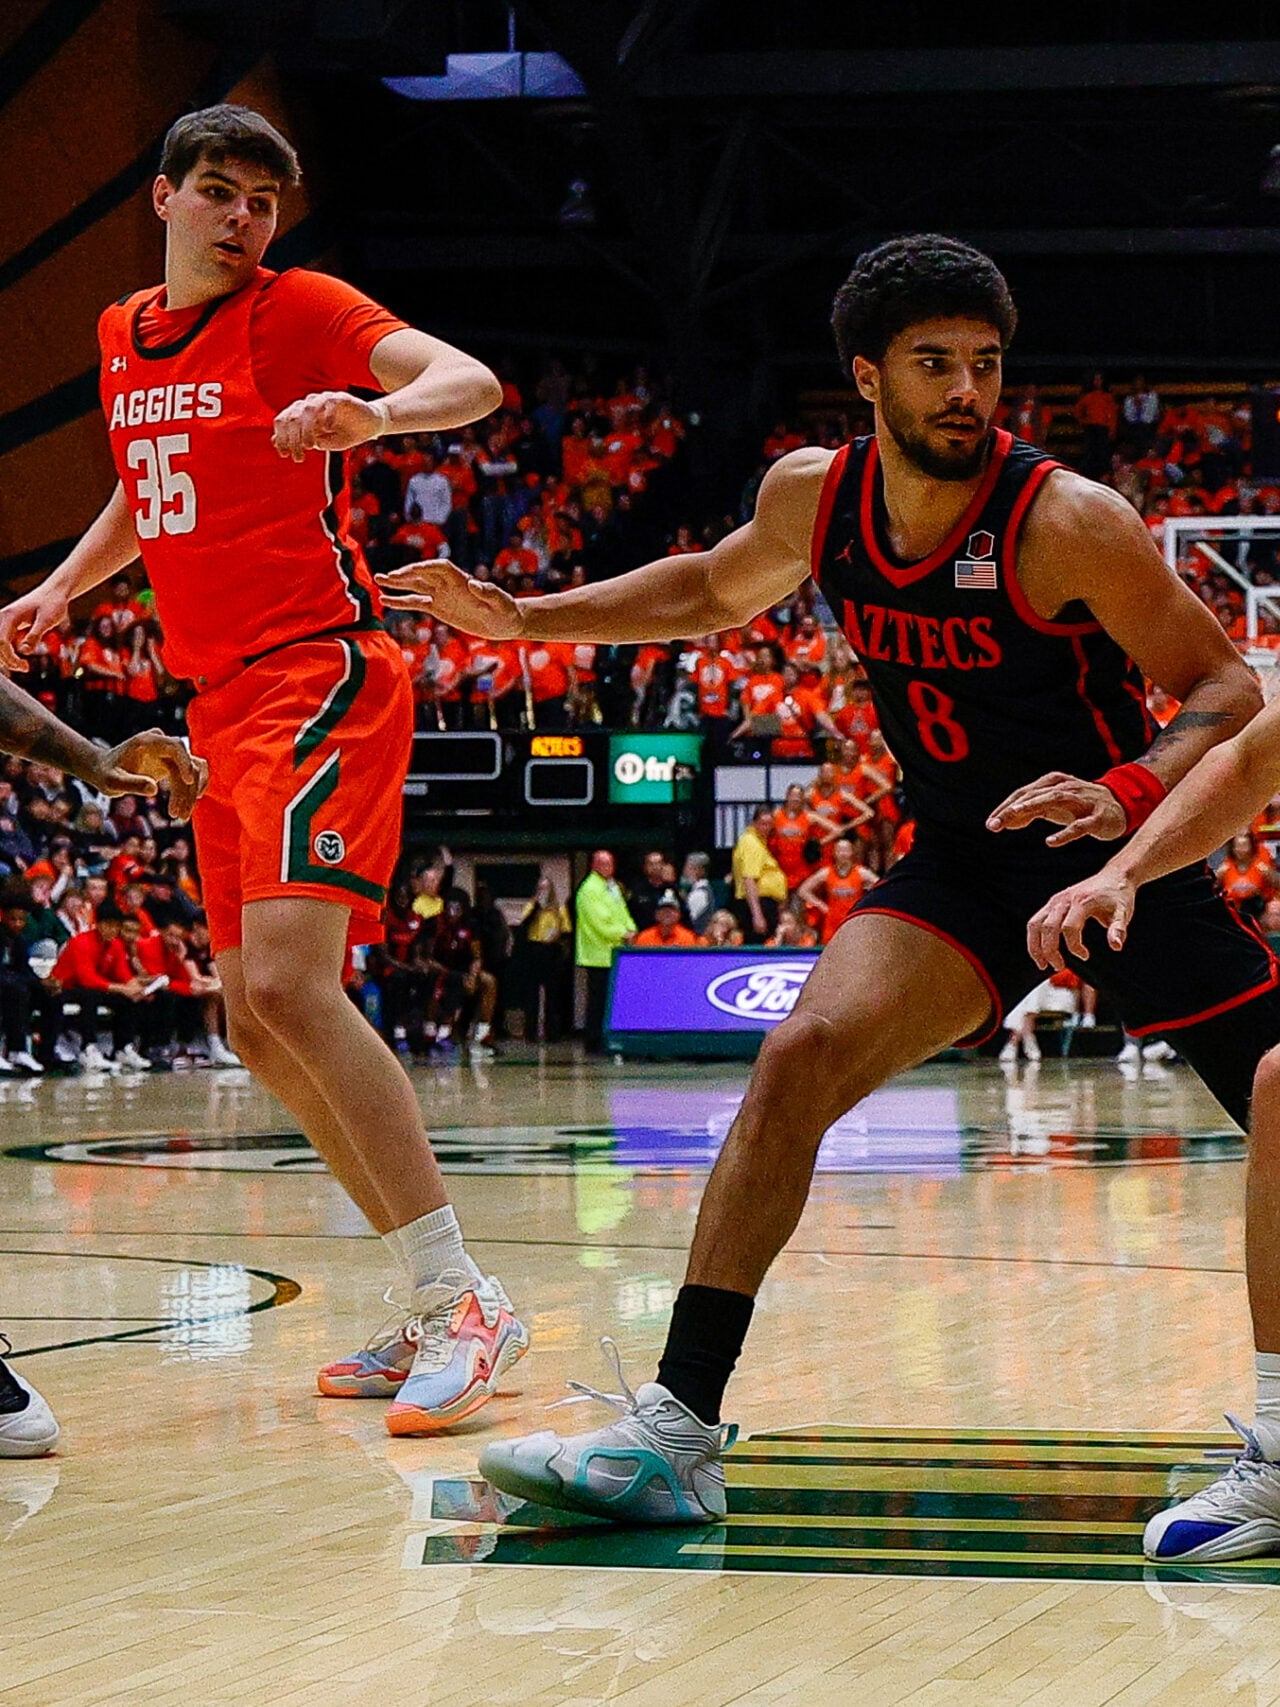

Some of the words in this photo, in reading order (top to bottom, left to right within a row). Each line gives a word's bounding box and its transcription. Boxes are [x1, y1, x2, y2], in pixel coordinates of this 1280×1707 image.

[109, 382, 223, 432] AGGIES
[127, 432, 197, 540] 35
[843, 599, 1003, 671] AZTECS
[907, 680, 970, 763] 8
